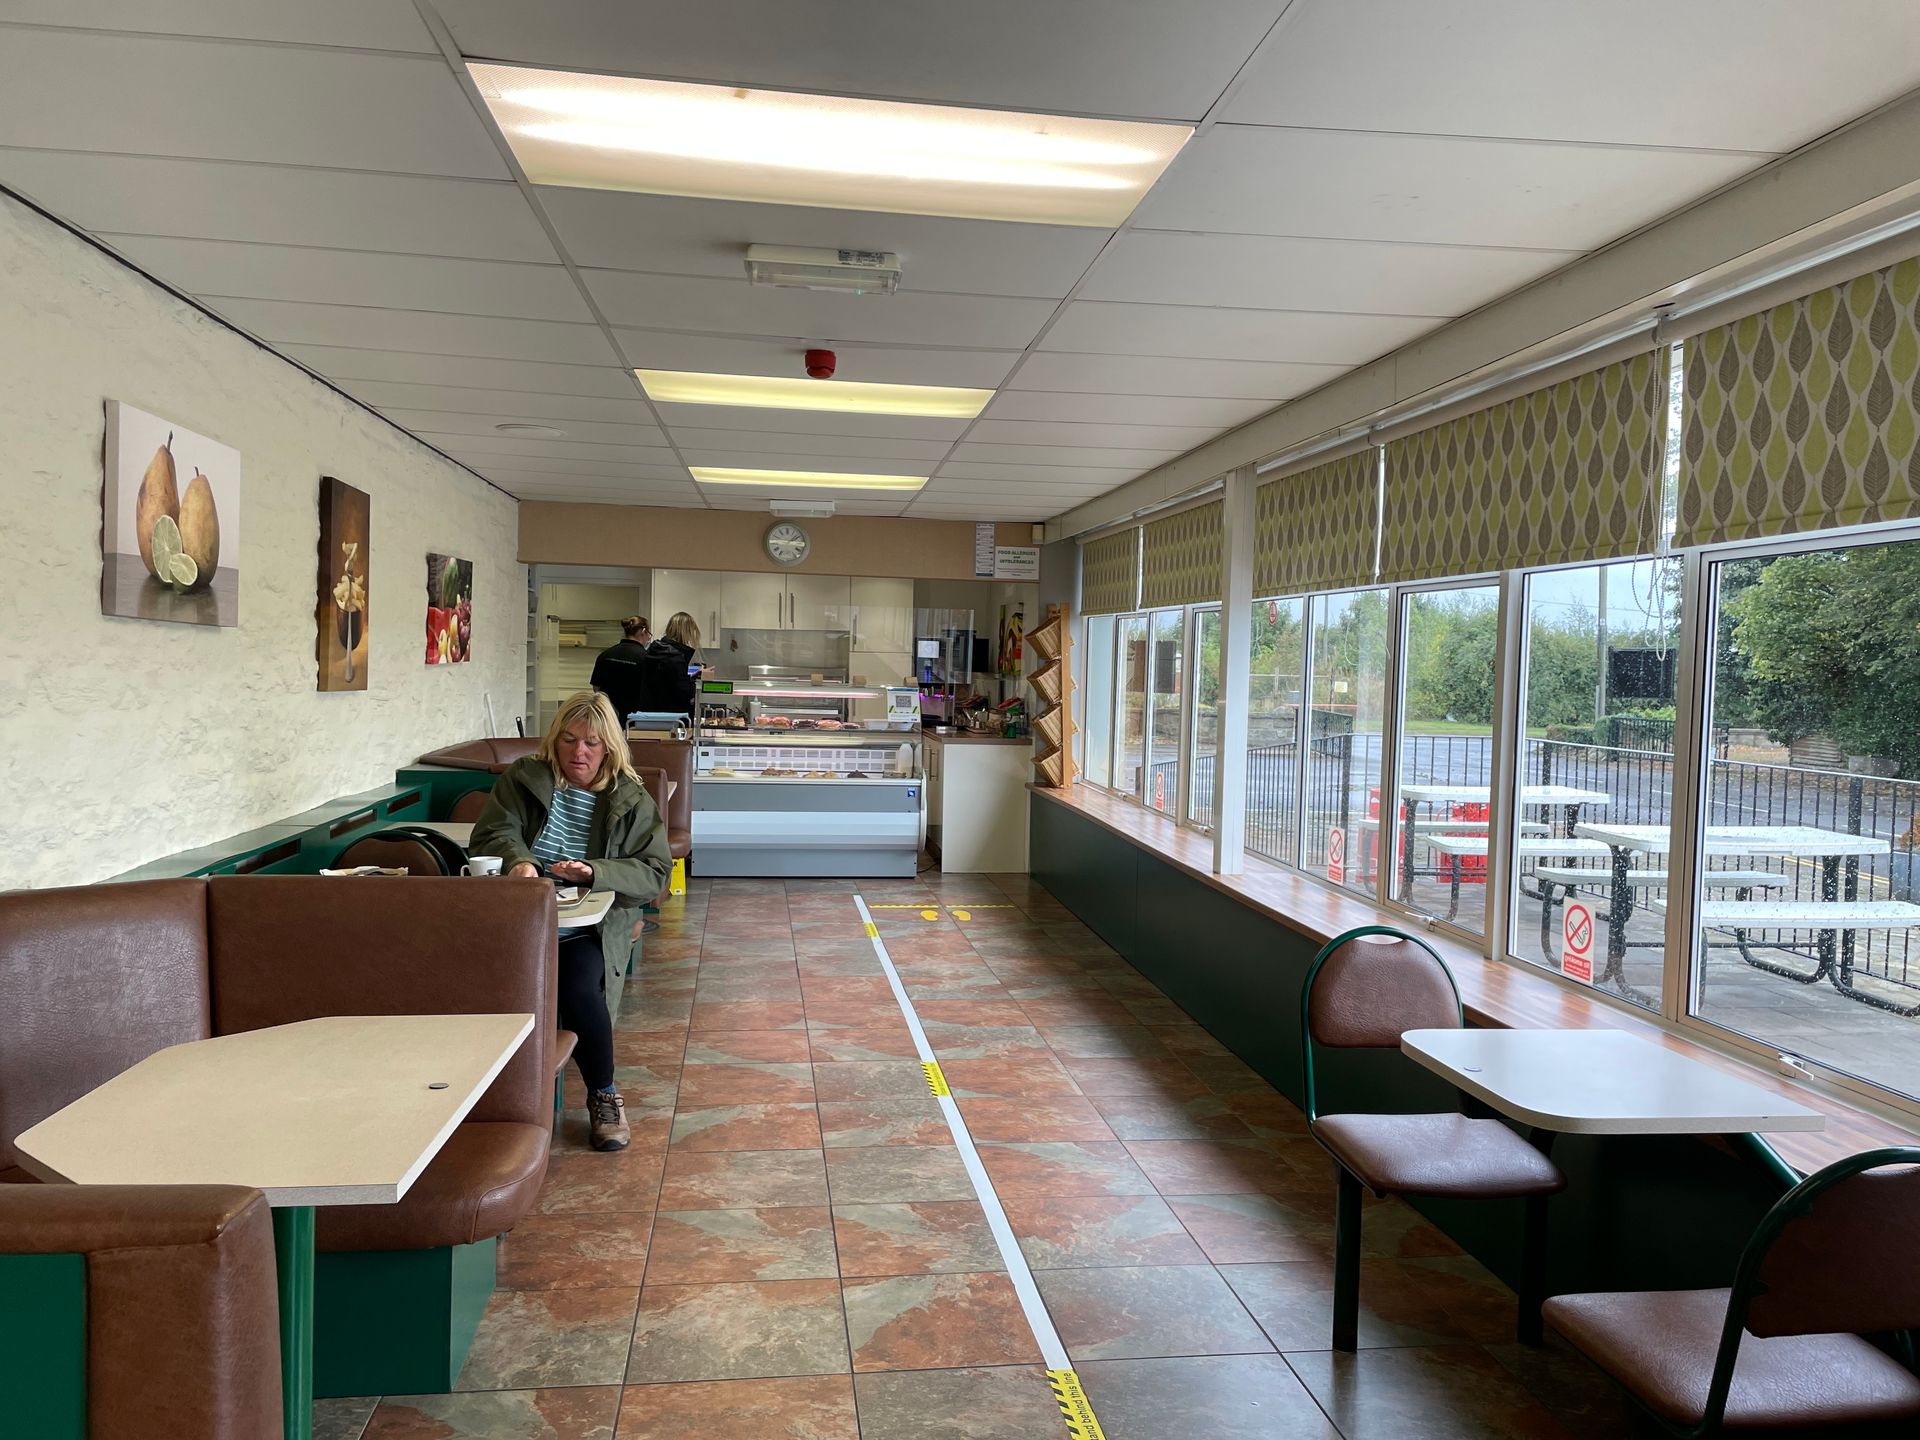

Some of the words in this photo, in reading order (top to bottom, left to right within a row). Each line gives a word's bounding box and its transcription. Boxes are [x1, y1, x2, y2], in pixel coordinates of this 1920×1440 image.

[1063, 1372, 1074, 1384] line
[1069, 1385, 1080, 1398] this
[1073, 1399, 1091, 1423] behind
[1083, 1425, 1099, 1440] and
